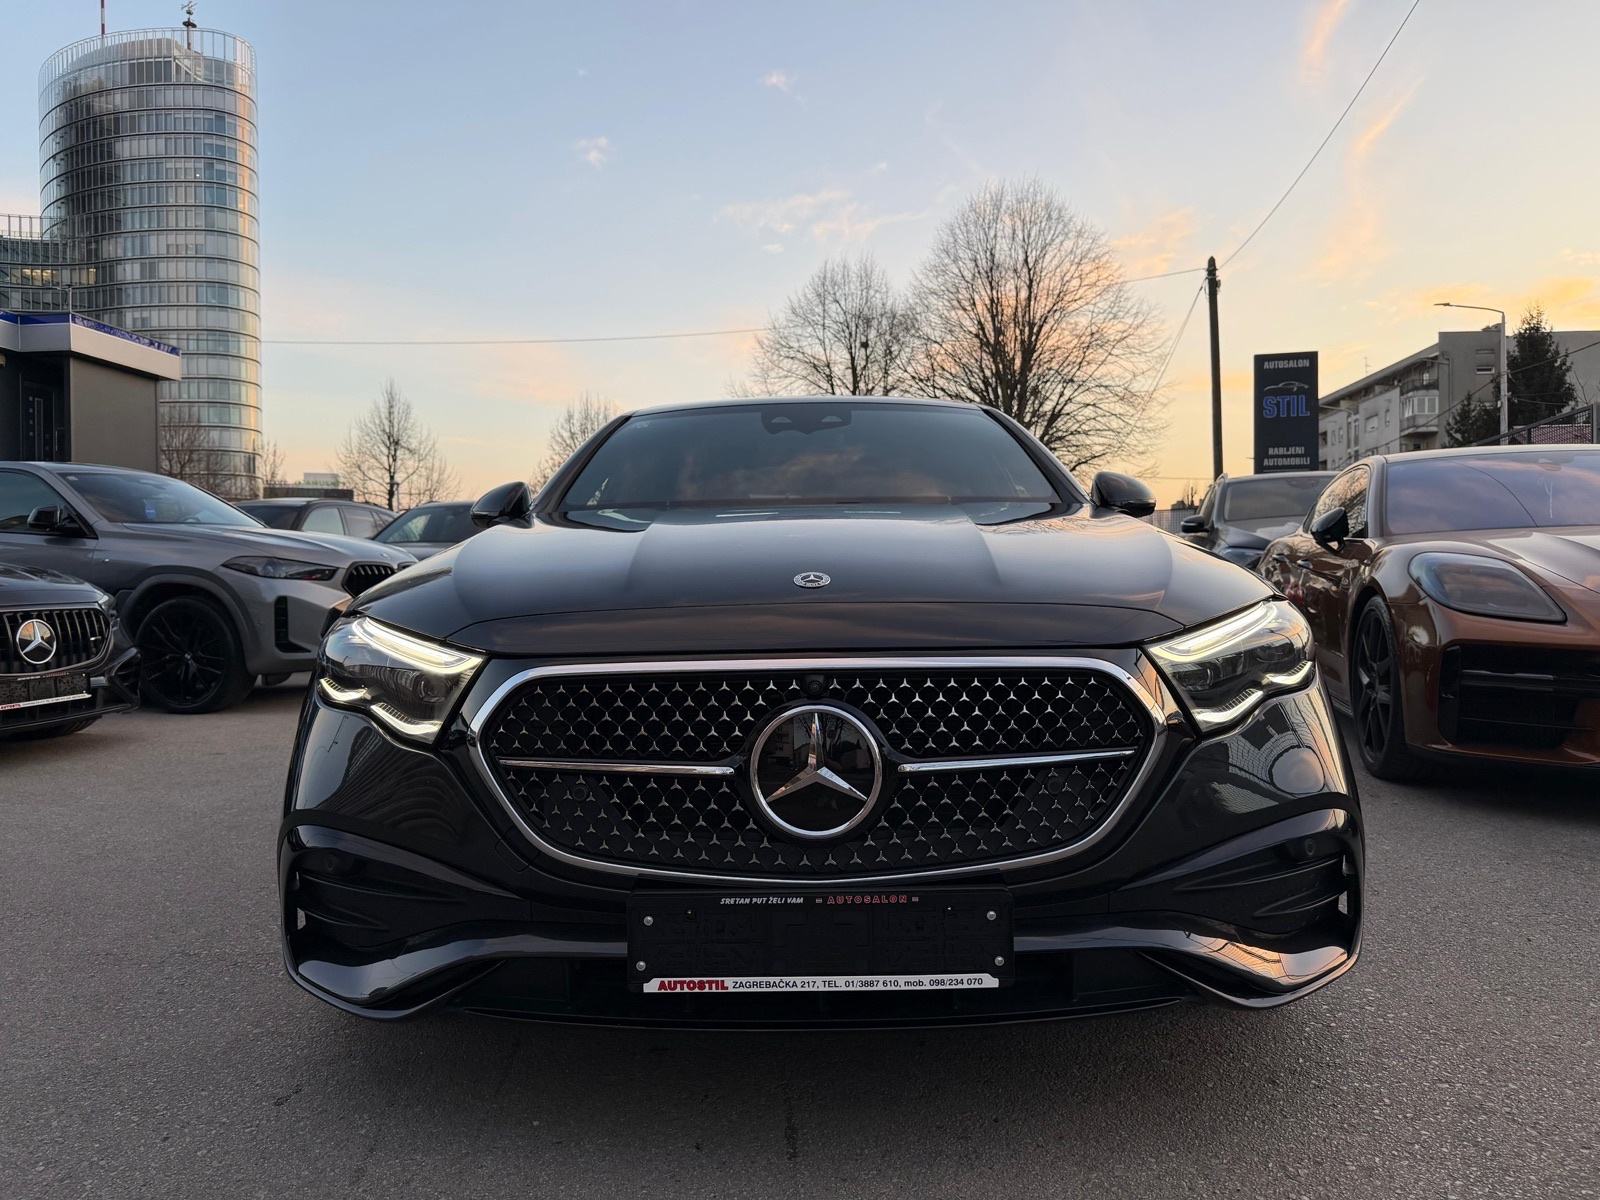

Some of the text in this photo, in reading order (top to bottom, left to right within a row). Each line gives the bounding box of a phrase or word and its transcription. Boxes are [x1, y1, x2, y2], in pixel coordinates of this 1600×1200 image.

[1263, 359, 1310, 370] AUTOSALON
[1263, 395, 1310, 418] STIL
[1268, 446, 1305, 455] RABLJENI
[1263, 457, 1310, 466] AUTOMOBILI
[767, 896, 786, 904] ŽELI
[826, 895, 908, 905] AUTOSALON
[657, 977, 983, 992] AUTOSTIL ZAGREBAČKA 217, TEL. 01/3887 610, mob. 098/234 070
